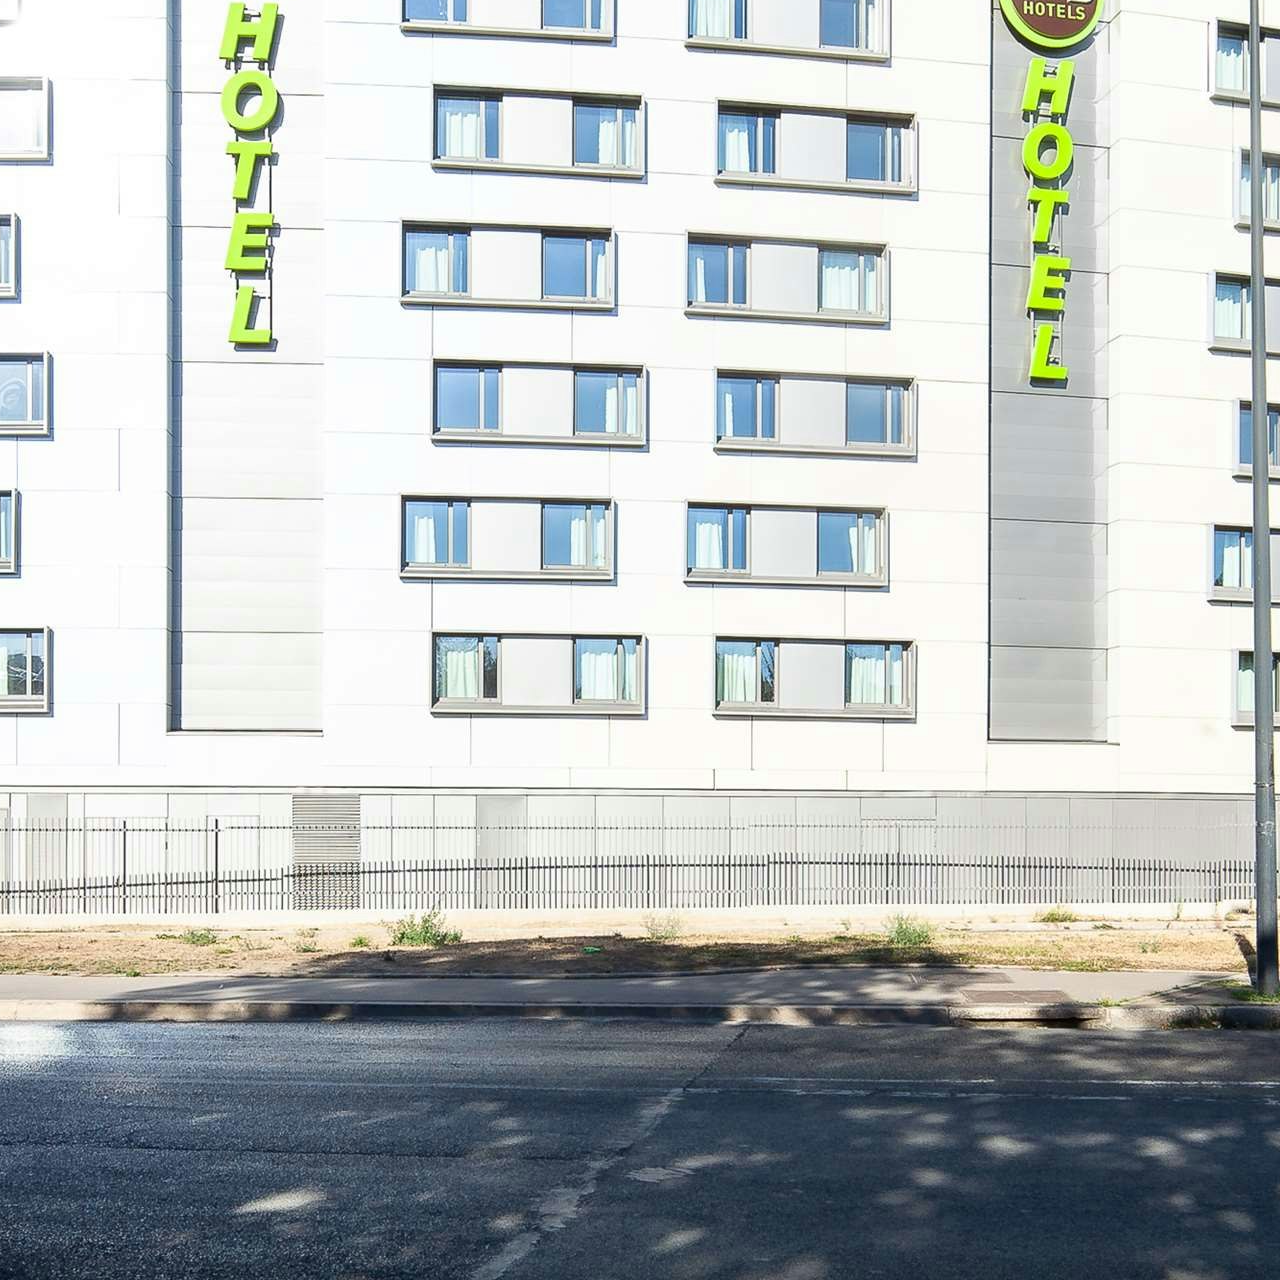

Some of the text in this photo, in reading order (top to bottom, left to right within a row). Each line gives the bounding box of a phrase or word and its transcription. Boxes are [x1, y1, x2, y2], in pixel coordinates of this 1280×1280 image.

[1023, 0, 1086, 20] HOTELS
[219, 2, 278, 344] HOTEL
[1021, 56, 1074, 381] HOTEL
